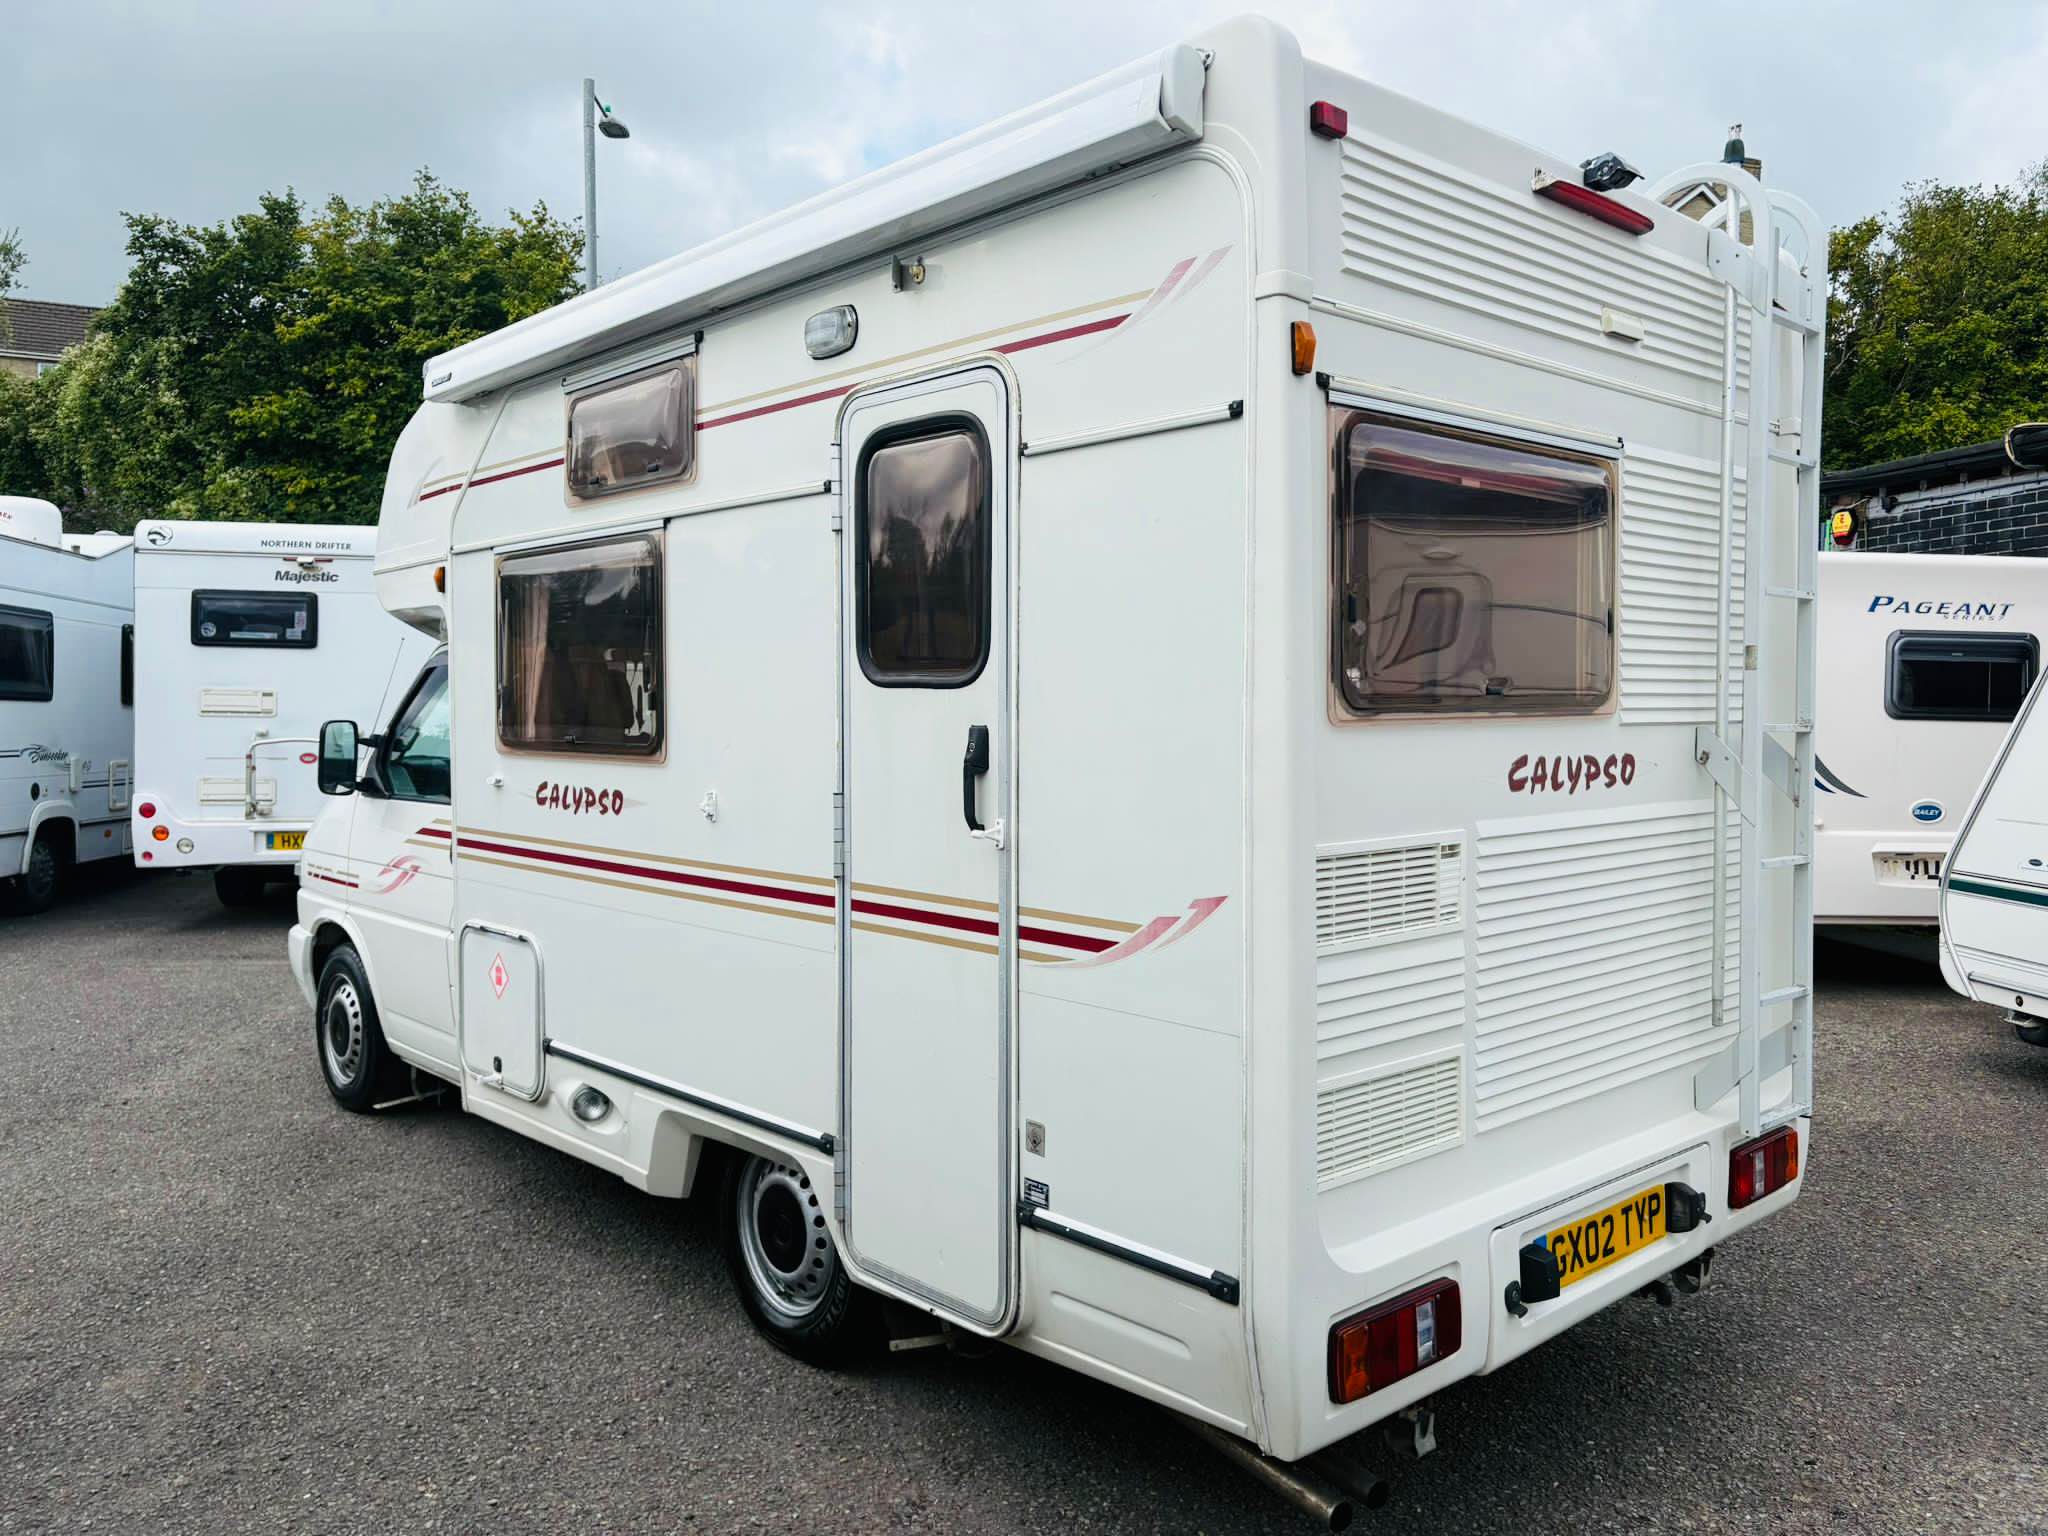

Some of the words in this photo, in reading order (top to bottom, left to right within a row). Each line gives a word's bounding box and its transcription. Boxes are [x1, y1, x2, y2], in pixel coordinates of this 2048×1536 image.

[261, 539, 312, 549] NORTHERN
[315, 541, 352, 550] DRIFTER
[274, 570, 340, 584] Majestic
[1867, 595, 2016, 616] PAGEANT
[1507, 753, 1636, 795] CALYPSO
[535, 781, 624, 816] CALYPSO
[281, 832, 305, 849] HX
[1551, 1213, 1616, 1277] GX02
[1621, 1191, 1661, 1249] TYP
